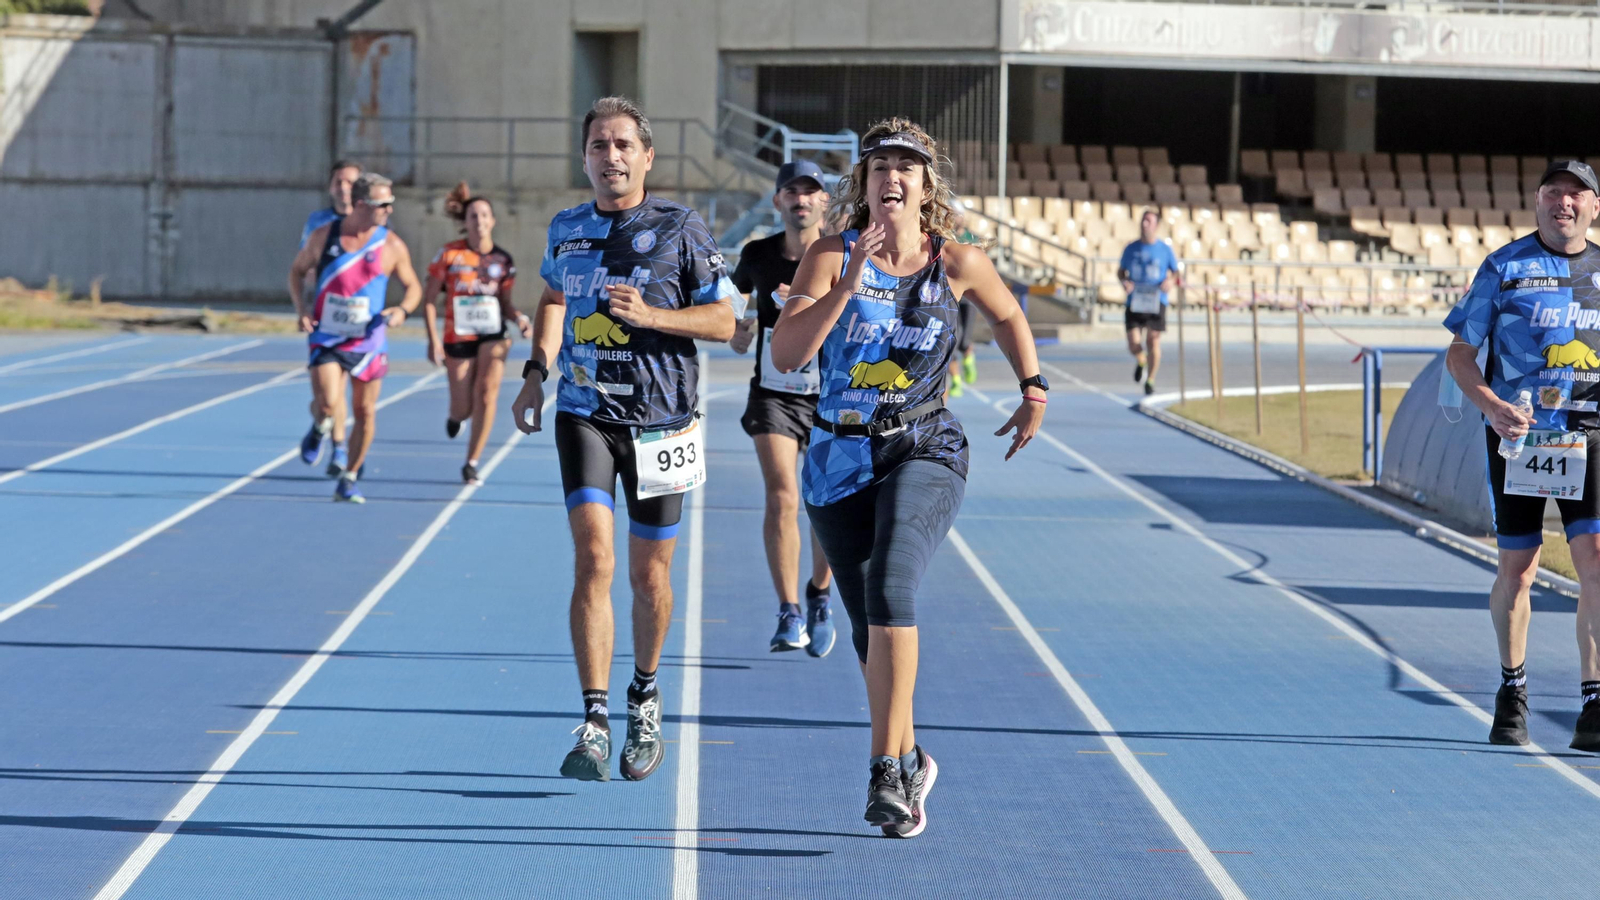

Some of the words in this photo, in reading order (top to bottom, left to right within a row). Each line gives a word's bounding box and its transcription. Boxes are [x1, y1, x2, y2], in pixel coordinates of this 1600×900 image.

[1071, 7, 1223, 49] Cruzcampo
[1431, 18, 1588, 59] Cruzcampo
[1530, 301, 1562, 327] LOS
[845, 312, 880, 345] LOS
[879, 318, 941, 351] PUPAS
[1539, 370, 1559, 380] RINO
[841, 391, 862, 402] RINO
[657, 442, 696, 472] 933
[1525, 455, 1567, 476] 441
